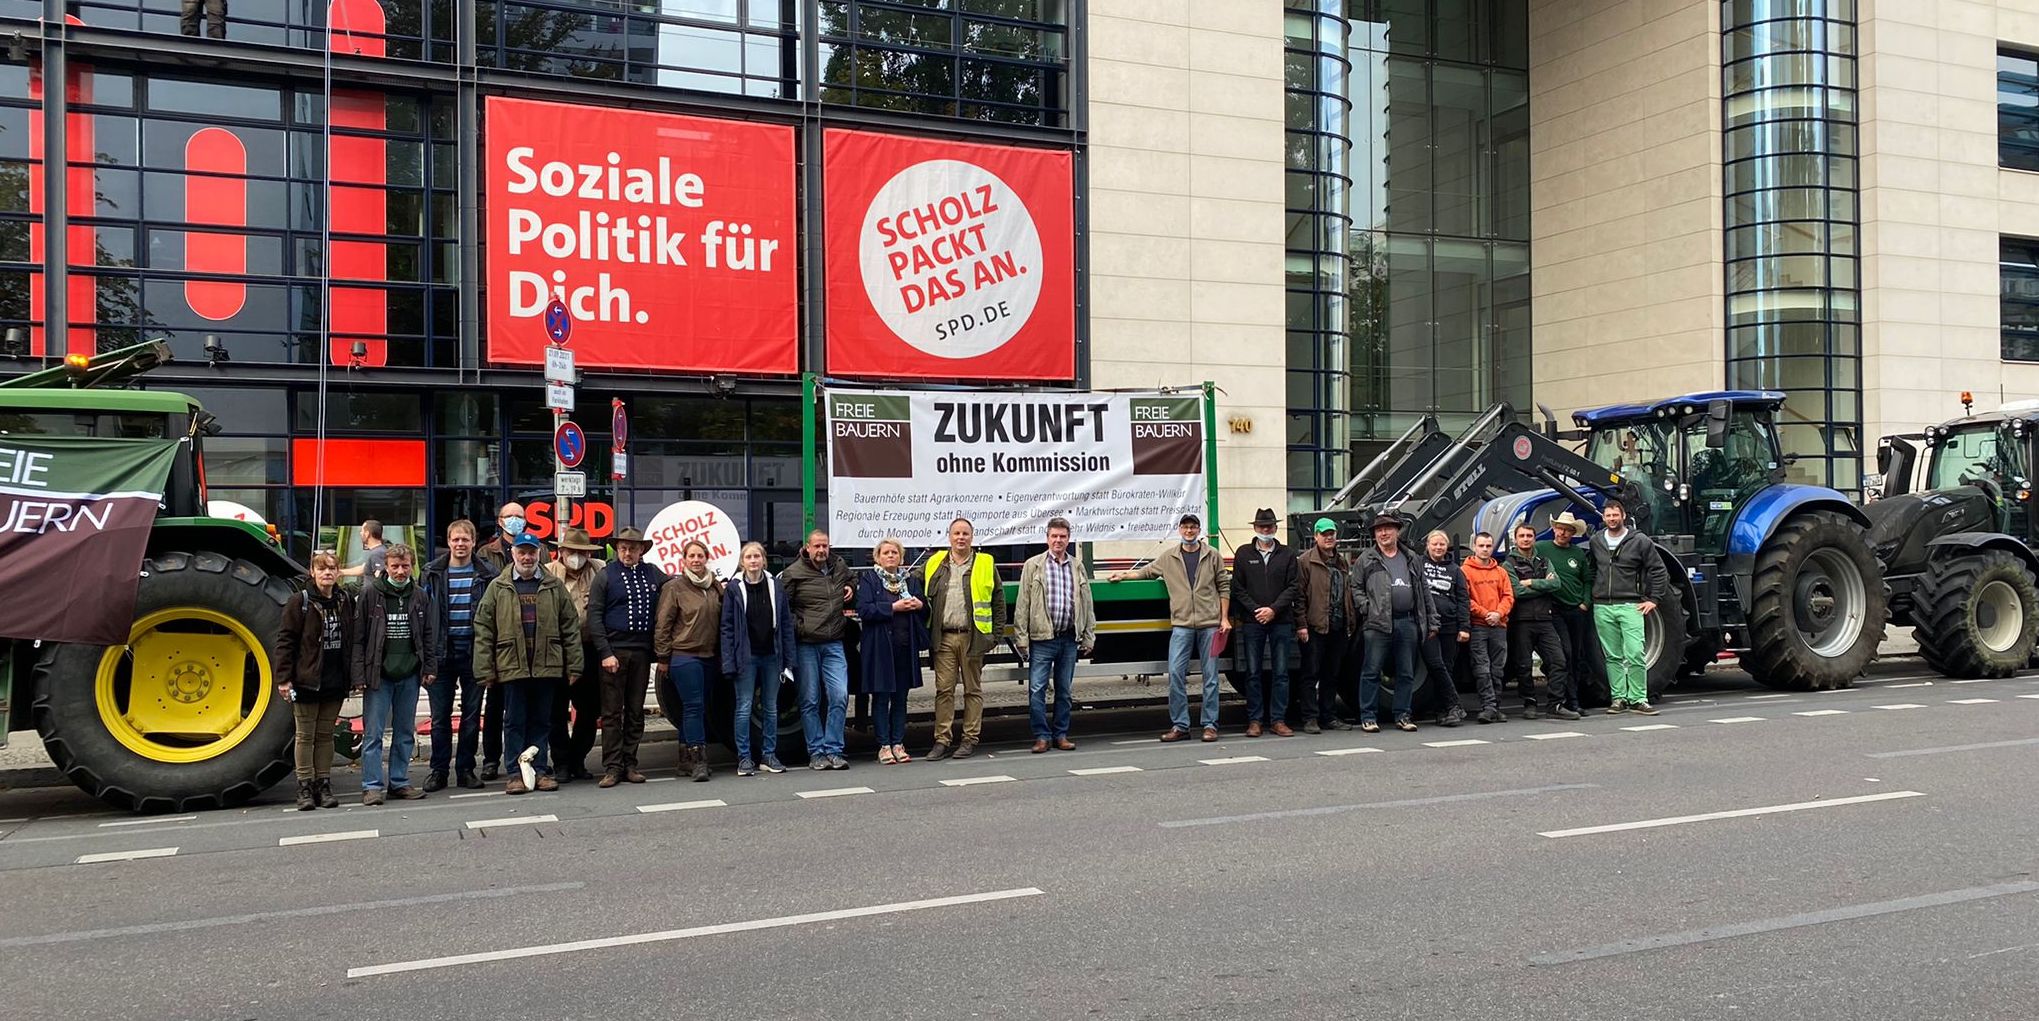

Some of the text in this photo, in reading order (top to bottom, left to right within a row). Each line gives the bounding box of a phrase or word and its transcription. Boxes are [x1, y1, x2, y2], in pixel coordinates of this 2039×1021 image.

[506, 147, 704, 207] Soziale
[876, 184, 998, 247] SCHOLZ
[509, 208, 778, 271] Politik für
[888, 223, 986, 281] PACKT
[509, 269, 649, 324] Dich.
[900, 250, 1027, 314] DAS AN.
[935, 301, 1011, 341] SPD.DE
[836, 403, 875, 418] FREIE
[934, 402, 1108, 443] ZUKUNFT
[1135, 406, 1170, 419] FREIE
[836, 422, 900, 438] BAUERN
[1135, 424, 1192, 438] BAUERN
[0, 449, 54, 486] EIE
[936, 451, 1110, 473] ohne Kommission
[854, 488, 1186, 505] Bauernhöfe statt Agrarkonzerne Eigenverantwortung statt Bürokraten-Willkür
[1453, 463, 1487, 500] STOLL
[525, 501, 614, 539] SPD
[652, 511, 717, 546] SCHOLZ
[836, 510, 881, 522] Regionale
[883, 510, 931, 522] Erzeugung
[933, 510, 953, 521] statt
[956, 509, 1010, 521] Billigimporte
[1012, 509, 1028, 518] aus
[1075, 506, 1140, 517] Marktwirtschaft
[1141, 505, 1159, 516] statt
[1161, 503, 1202, 515] Preisdiktat
[858, 527, 884, 538] durch
[886, 527, 932, 539] Monopole
[1017, 524, 1036, 534] statt
[1086, 521, 1115, 533] Wildnis
[663, 558, 685, 577] DA
